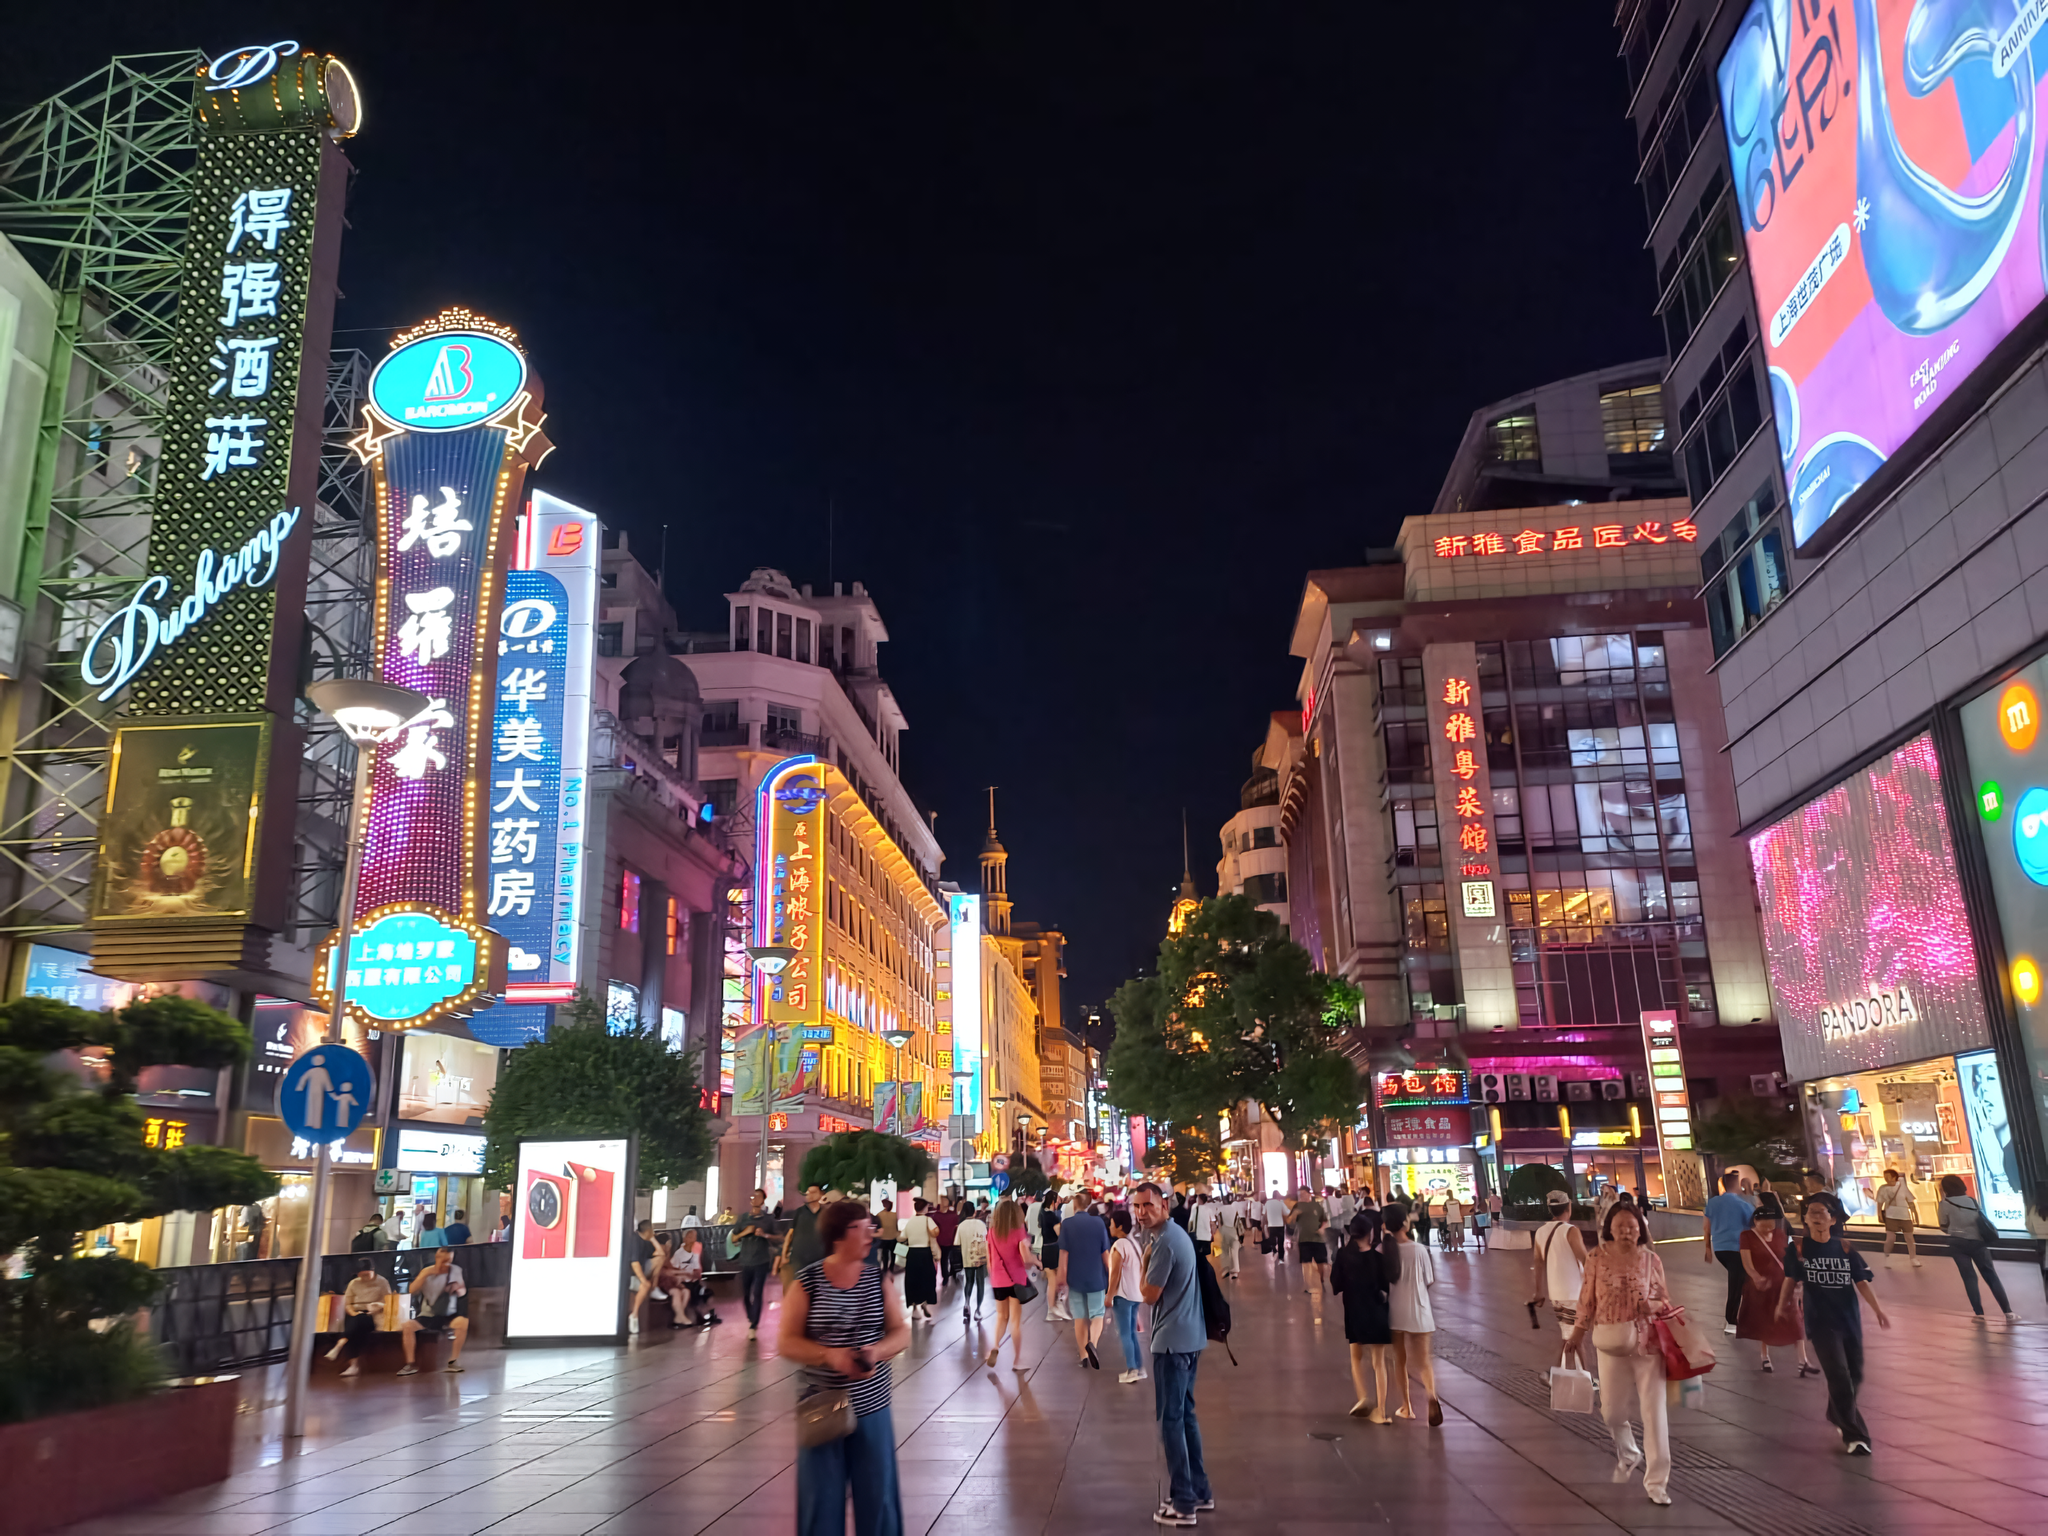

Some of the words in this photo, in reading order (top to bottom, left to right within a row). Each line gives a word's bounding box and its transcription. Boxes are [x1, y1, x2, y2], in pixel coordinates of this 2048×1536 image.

[202, 187, 293, 481] 得强酒莊
[1778, 234, 1843, 338] 上海世茂广场
[80, 506, 300, 702] Duchamp
[487, 667, 548, 916] 华美大药房
[553, 842, 580, 965] Pharmacy
[1821, 986, 1917, 1041] PANDORA
